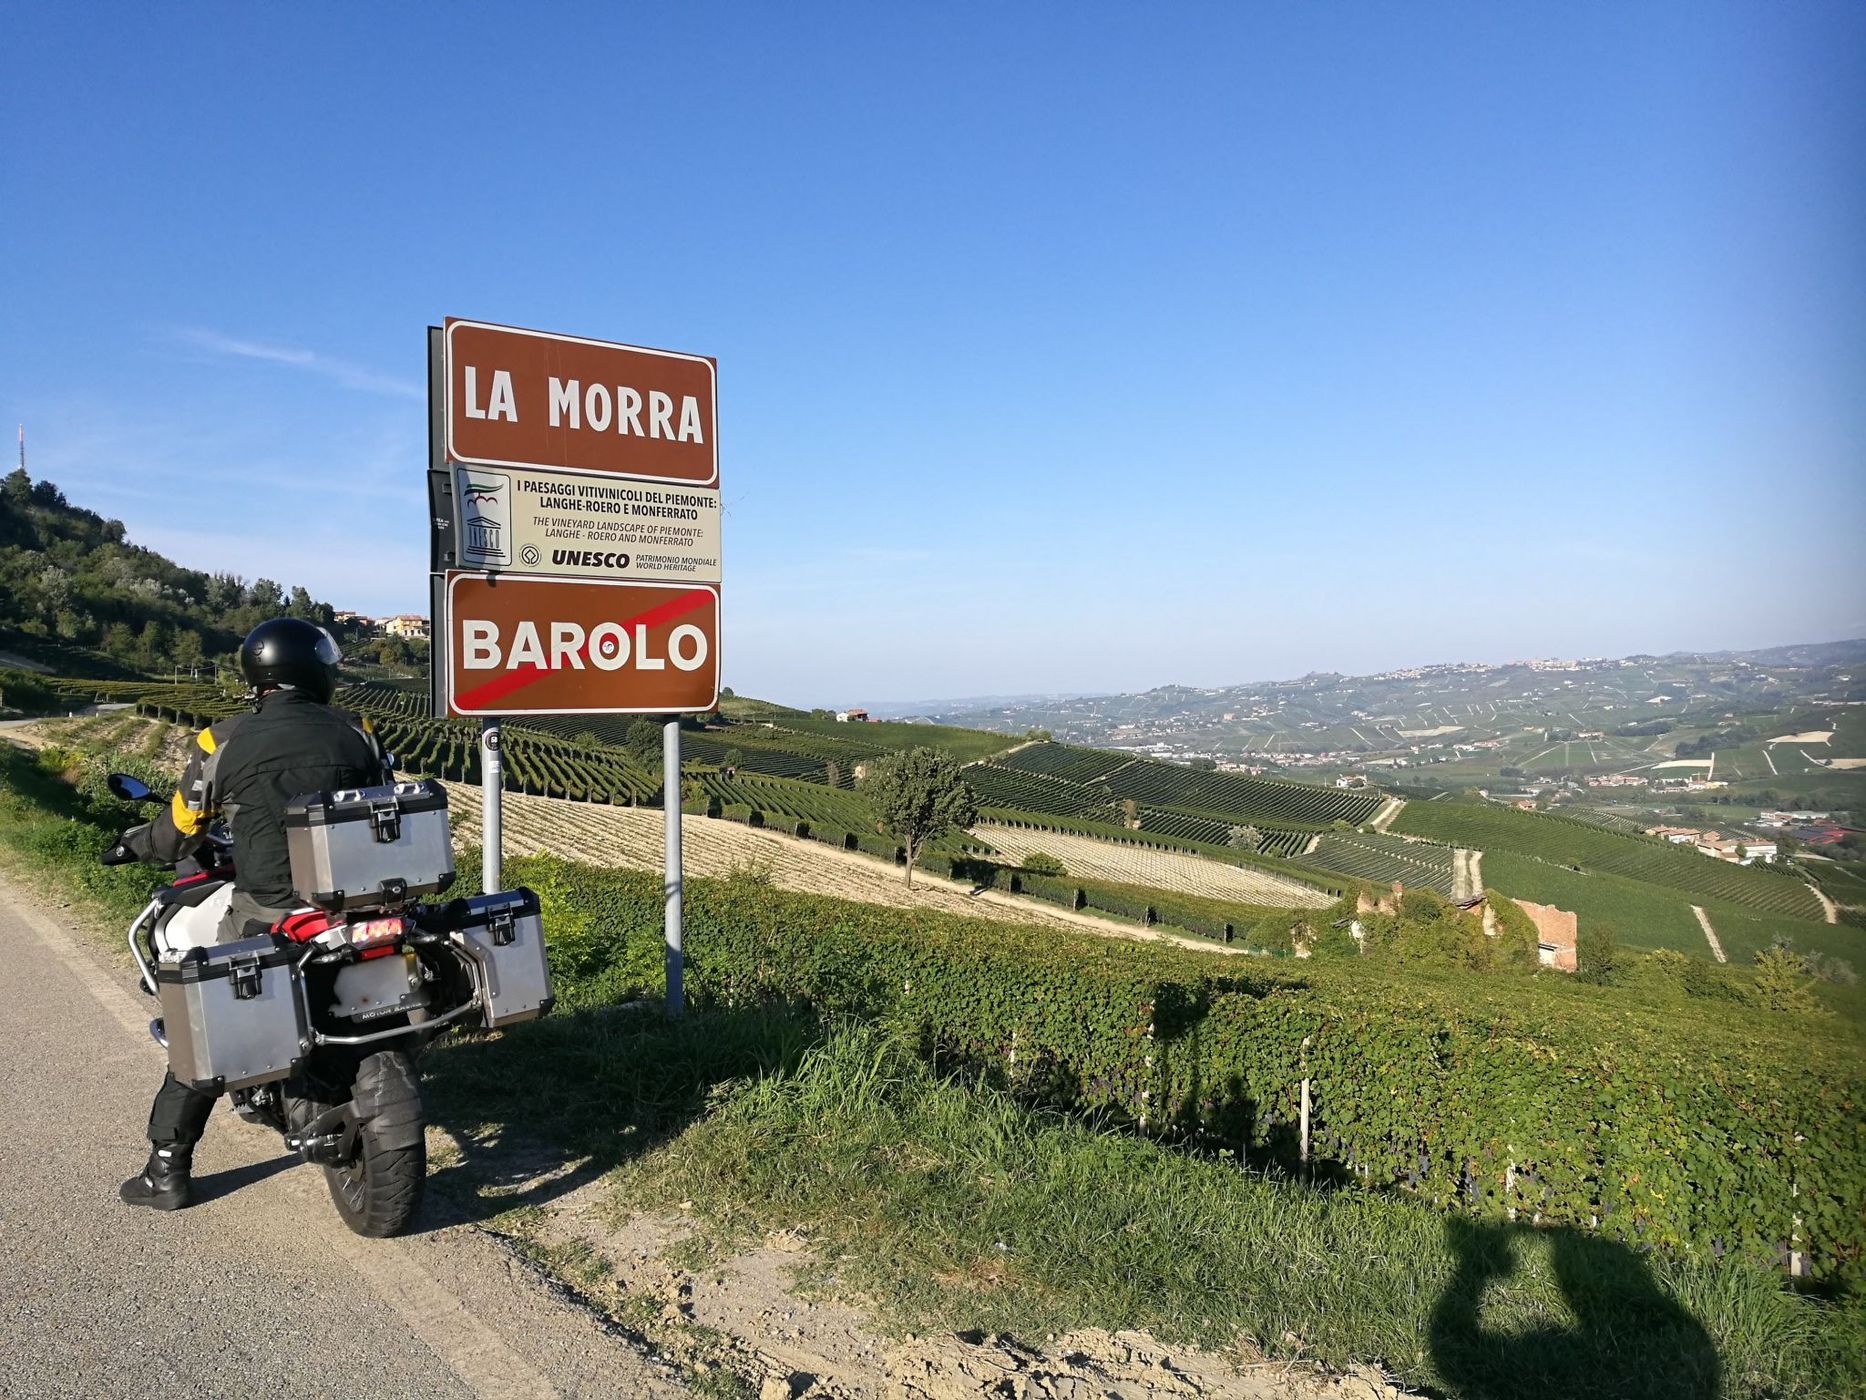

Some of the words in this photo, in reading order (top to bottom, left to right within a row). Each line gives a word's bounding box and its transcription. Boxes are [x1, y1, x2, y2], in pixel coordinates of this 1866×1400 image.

[465, 366, 518, 422] LA
[548, 377, 704, 444] MORRA
[517, 480, 520, 491] I
[524, 480, 576, 496] PAESAGGI
[578, 486, 643, 502] VITIVINICOLI
[646, 492, 663, 503] DEL
[665, 494, 717, 508] PIEMONTE:
[540, 497, 620, 514] LANGHE-ROERO
[624, 503, 629, 514] E
[632, 504, 698, 520] MONFERRATO
[533, 517, 550, 526] THE
[552, 518, 595, 529] VINEYARD
[597, 522, 645, 533] LANDSCAPE
[647, 525, 659, 534] OF
[660, 526, 703, 537] PIEMONTE:
[545, 528, 580, 539] LANGHE
[588, 531, 617, 541] ROERO
[618, 533, 637, 542] AND
[638, 535, 693, 546] MONFERRATO
[552, 550, 630, 568] UNESCO
[636, 555, 679, 564] PATRIMONIO
[681, 557, 717, 566] MONDIALE
[636, 561, 662, 570] WORLD
[664, 564, 696, 572] HERITAGE
[463, 620, 707, 672] BAROLO
